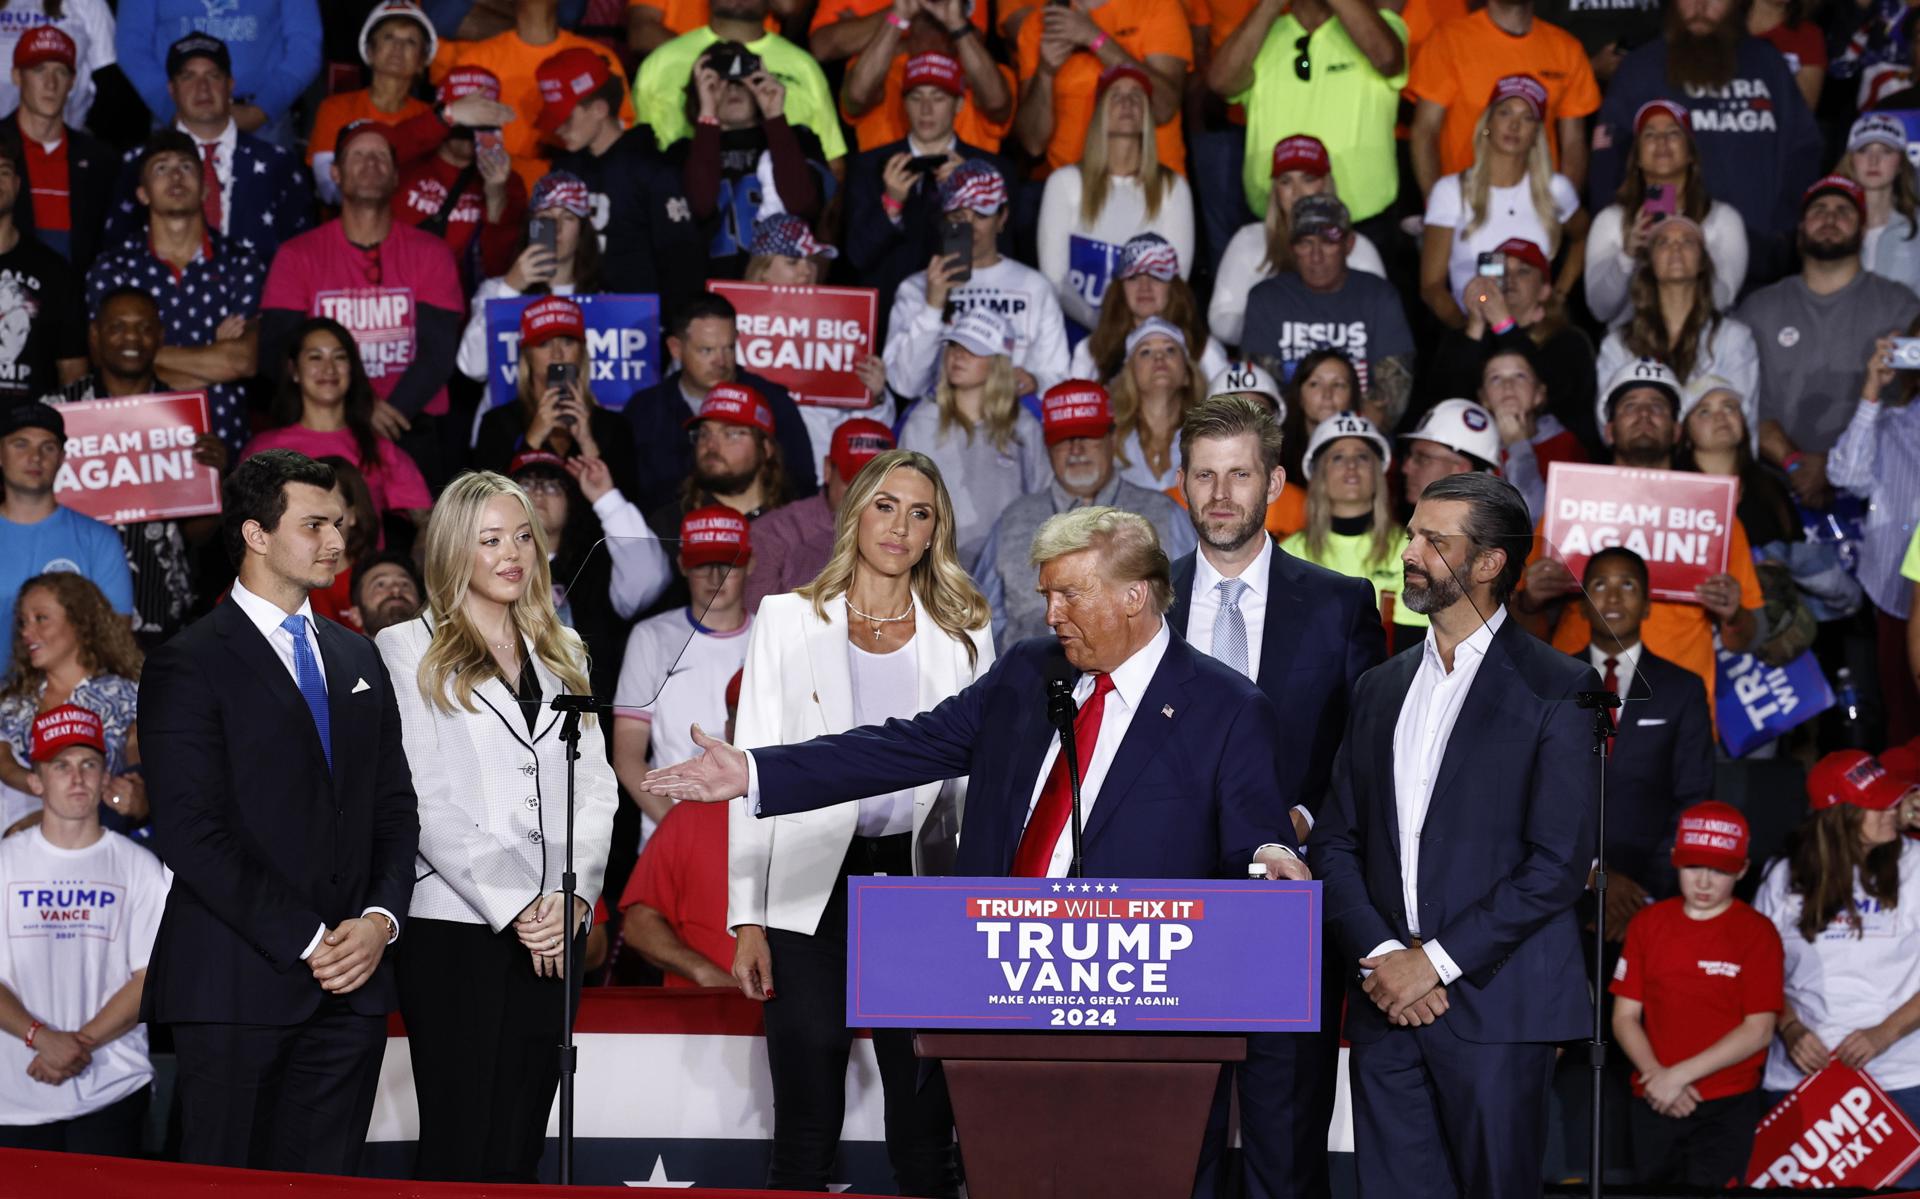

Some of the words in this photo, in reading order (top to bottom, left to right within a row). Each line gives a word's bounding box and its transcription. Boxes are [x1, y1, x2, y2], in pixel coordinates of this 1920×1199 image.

[1691, 109, 1776, 132] MAGA
[0, 269, 41, 290] ALD
[322, 295, 408, 330] TRUMP
[737, 314, 810, 338] REAM
[816, 319, 867, 345] BIG,
[1278, 321, 1368, 349] JESUS
[498, 329, 647, 362] TMP
[622, 361, 646, 380] IT
[1227, 372, 1257, 388] NO
[63, 431, 142, 460] REAM
[53, 449, 195, 493] AGAIN!
[1559, 499, 1661, 528] DREAM
[1667, 507, 1724, 536] BIG,
[18, 889, 115, 908] TRUMP
[977, 900, 1057, 916] TRUMP
[1064, 901, 1121, 917] WILL
[1129, 902, 1165, 918] FIX
[1172, 902, 1193, 918] IT
[40, 910, 91, 921] VANCE
[976, 922, 1194, 960] TRUMP
[1000, 961, 1167, 992] VANCE
[989, 995, 1024, 1005] MAKE
[1029, 996, 1085, 1005] AMERICA
[1089, 996, 1130, 1006] GREAT
[1135, 997, 1179, 1006] AGAIN!
[1051, 1008, 1116, 1026] 2024
[1827, 1134, 1873, 1181] FIX
[1866, 1112, 1893, 1145] IT
